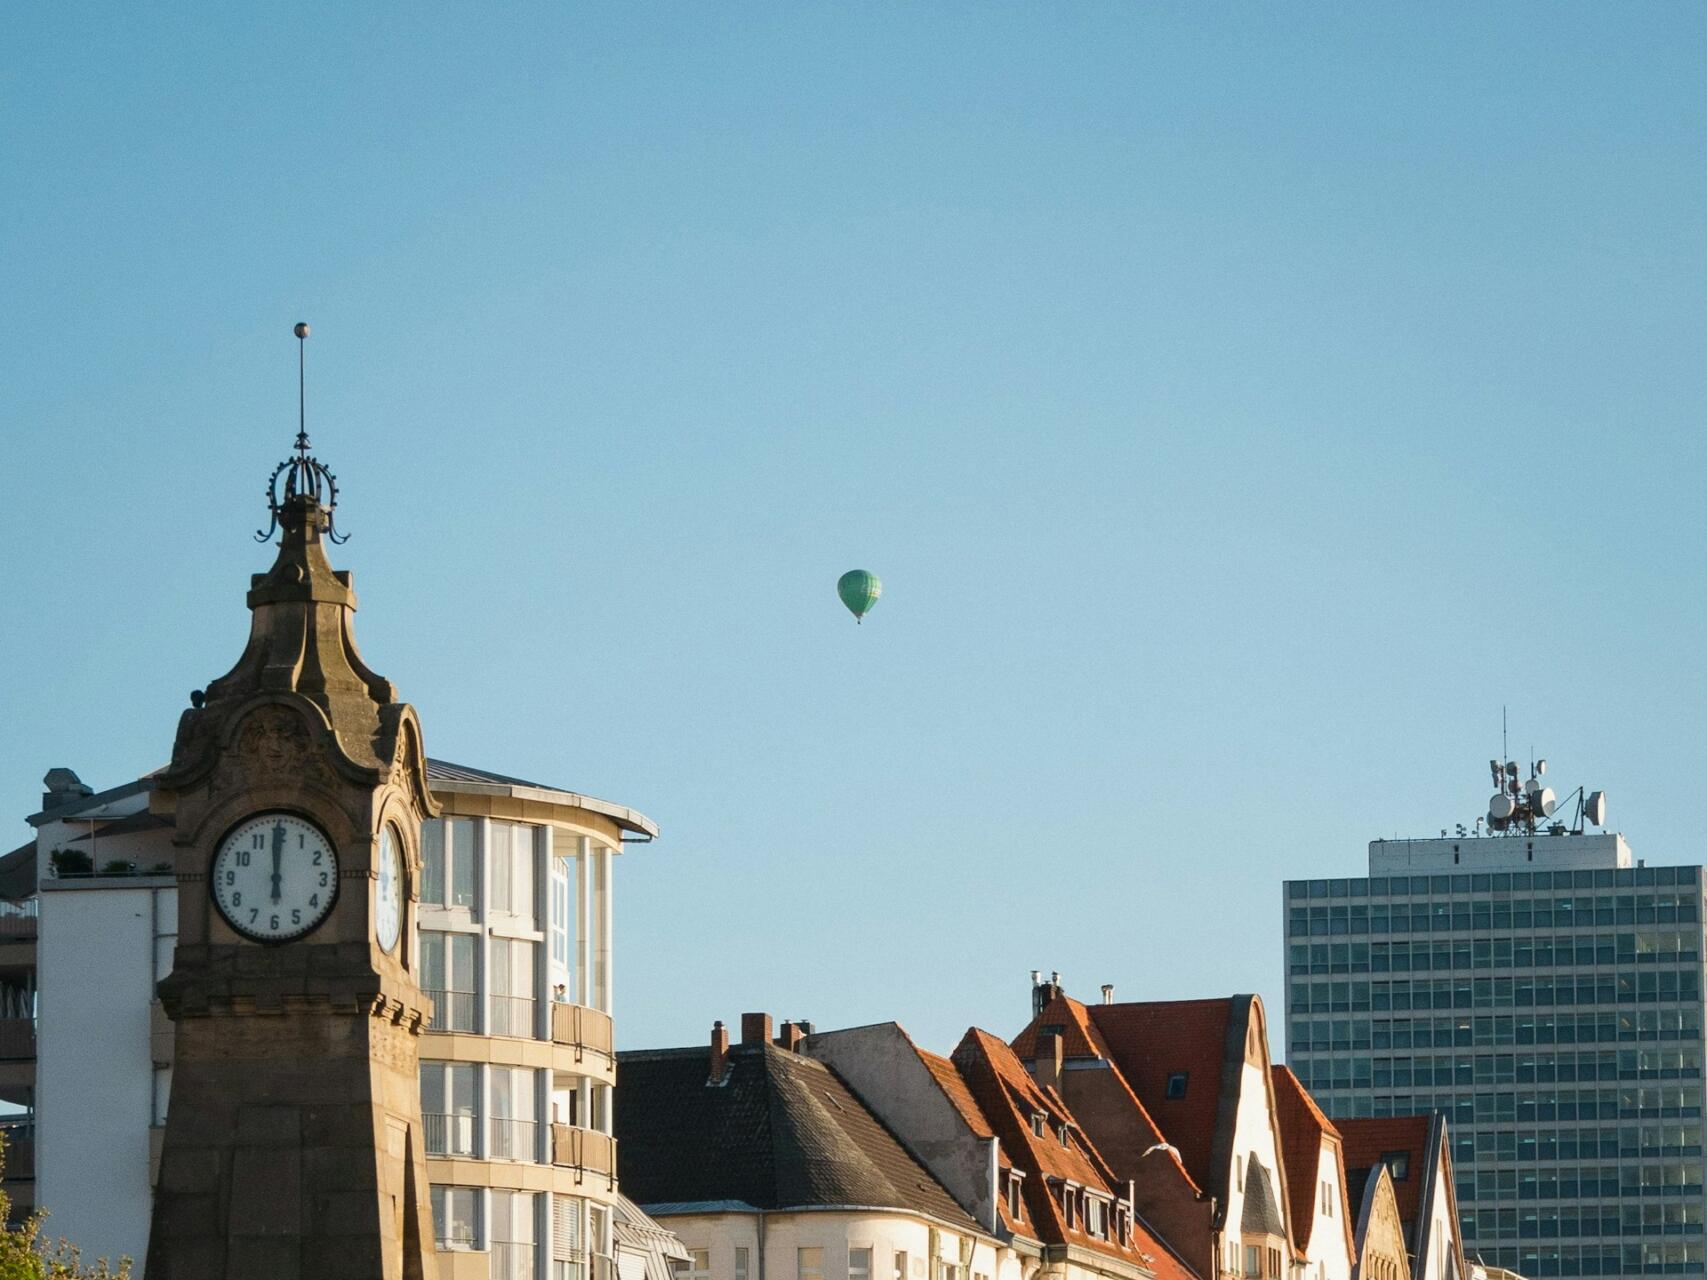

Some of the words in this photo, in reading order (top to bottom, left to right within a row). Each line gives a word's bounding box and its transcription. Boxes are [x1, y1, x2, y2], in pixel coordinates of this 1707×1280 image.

[252, 834, 265, 850] 11
[298, 834, 304, 849] 1
[236, 851, 250, 867] 10
[312, 852, 322, 866] 2
[226, 871, 235, 886] 9
[319, 872, 328, 887] 3
[232, 892, 241, 907] 8
[309, 893, 318, 909] 4
[250, 908, 259, 924] 7
[270, 915, 280, 930] 6
[292, 909, 301, 925] 5
